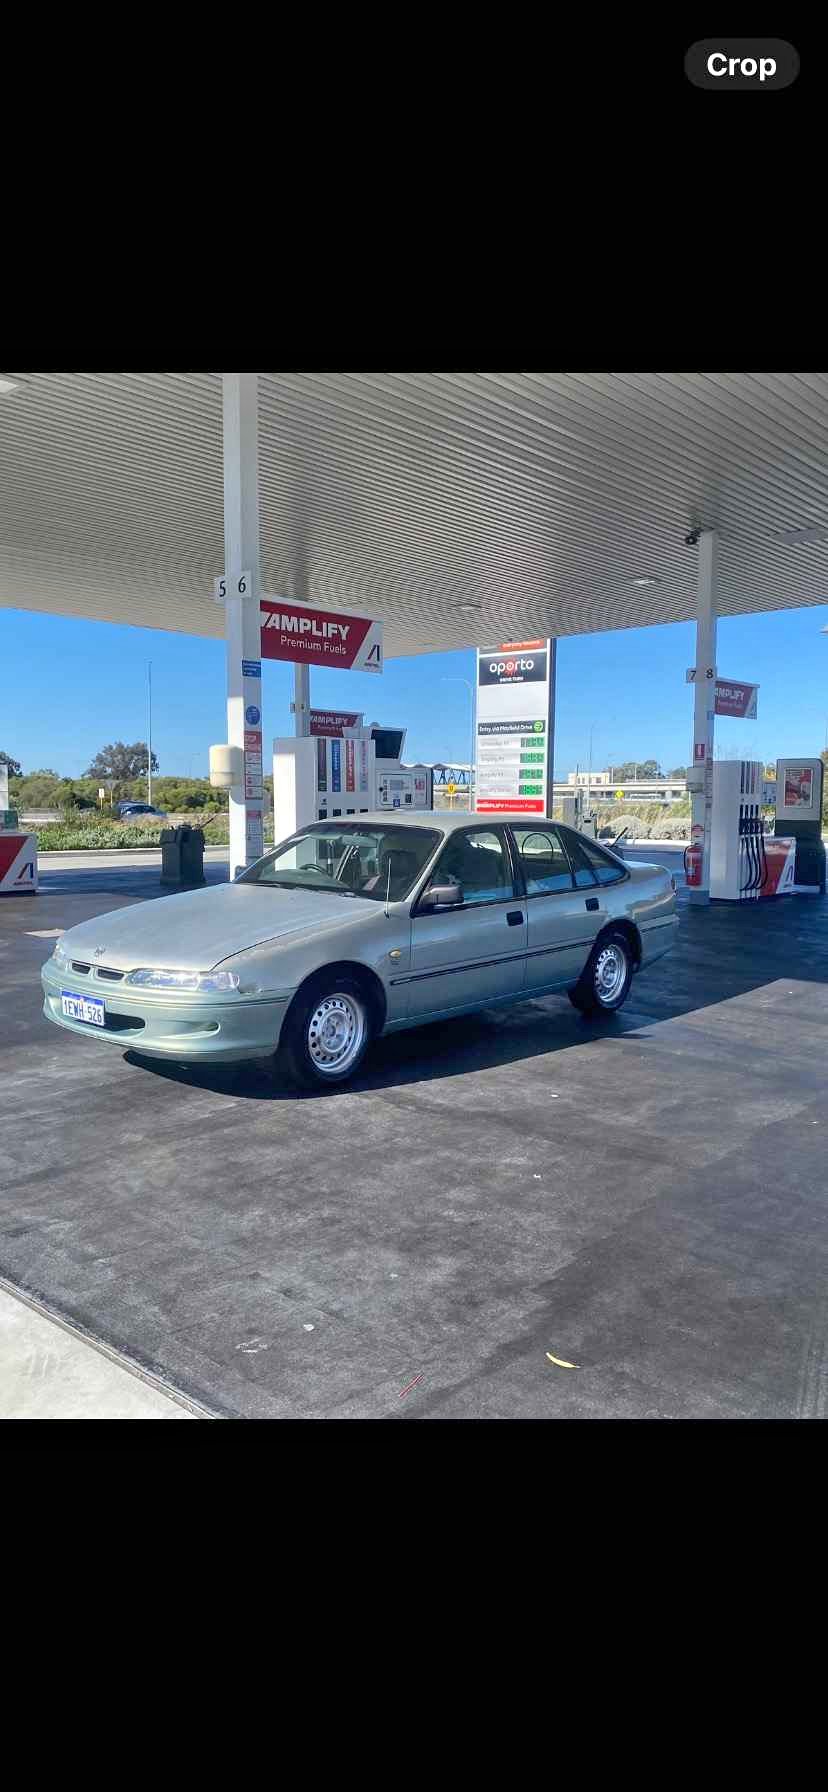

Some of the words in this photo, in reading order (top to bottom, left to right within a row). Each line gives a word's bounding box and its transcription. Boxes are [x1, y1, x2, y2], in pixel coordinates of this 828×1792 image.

[219, 580, 226, 597] 5
[238, 576, 246, 593] 6
[263, 612, 350, 641] AMPLIFY
[281, 635, 322, 651] Premium
[324, 641, 347, 655] Fuels
[489, 658, 534, 676] oporto
[690, 670, 697, 680] 7
[706, 669, 713, 679] 8
[65, 1000, 84, 1019] 1EWH
[87, 1006, 102, 1023] 526
